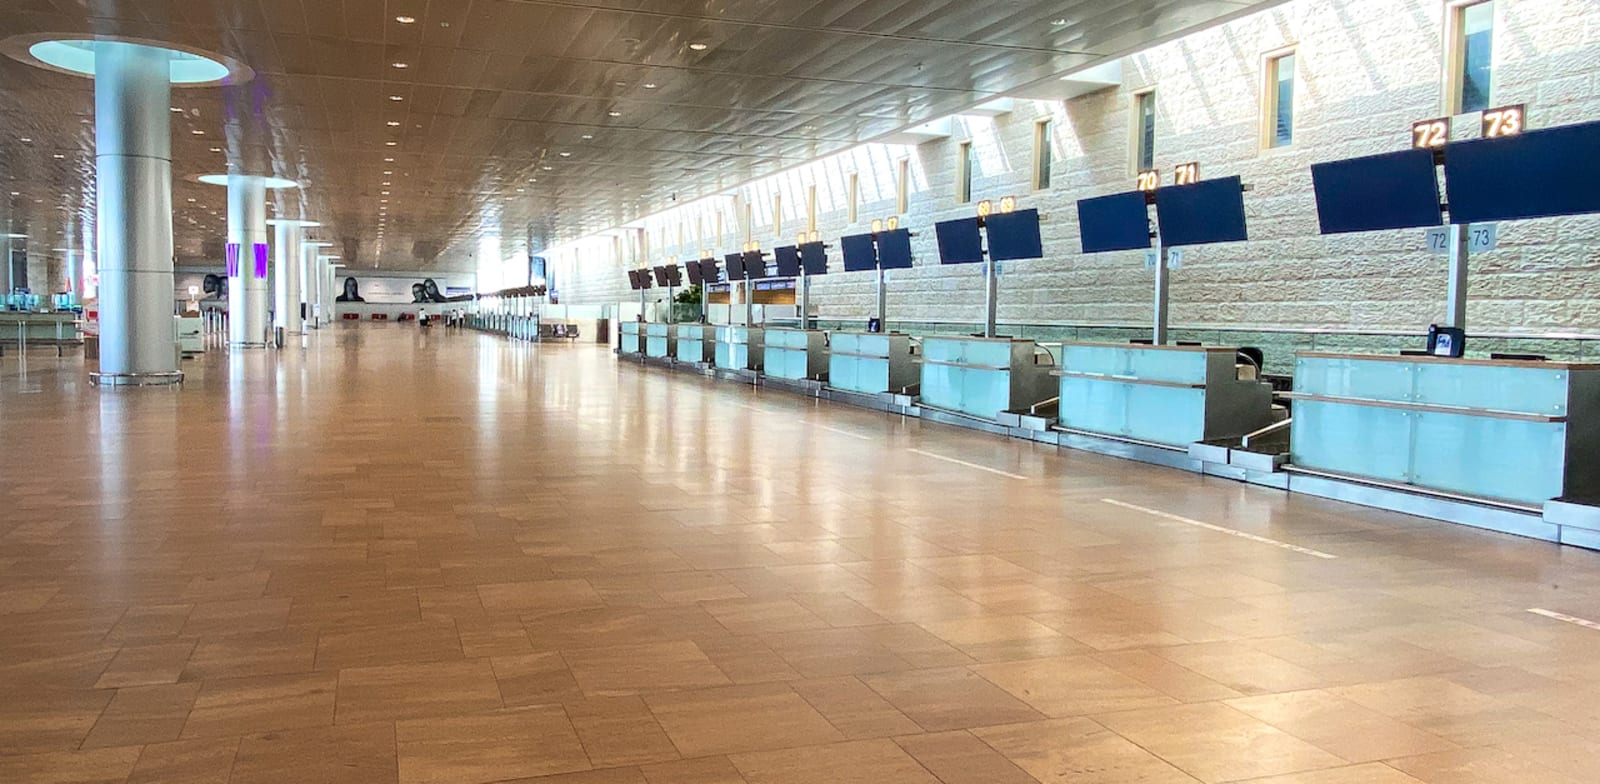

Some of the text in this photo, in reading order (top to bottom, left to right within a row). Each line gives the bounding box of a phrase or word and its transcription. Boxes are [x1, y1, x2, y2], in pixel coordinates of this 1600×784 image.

[1484, 110, 1520, 138] 73
[1414, 122, 1447, 148] 72
[1138, 171, 1157, 191] 70
[1177, 164, 1196, 185] 71
[1432, 232, 1446, 249] 72
[1473, 229, 1490, 247] 73
